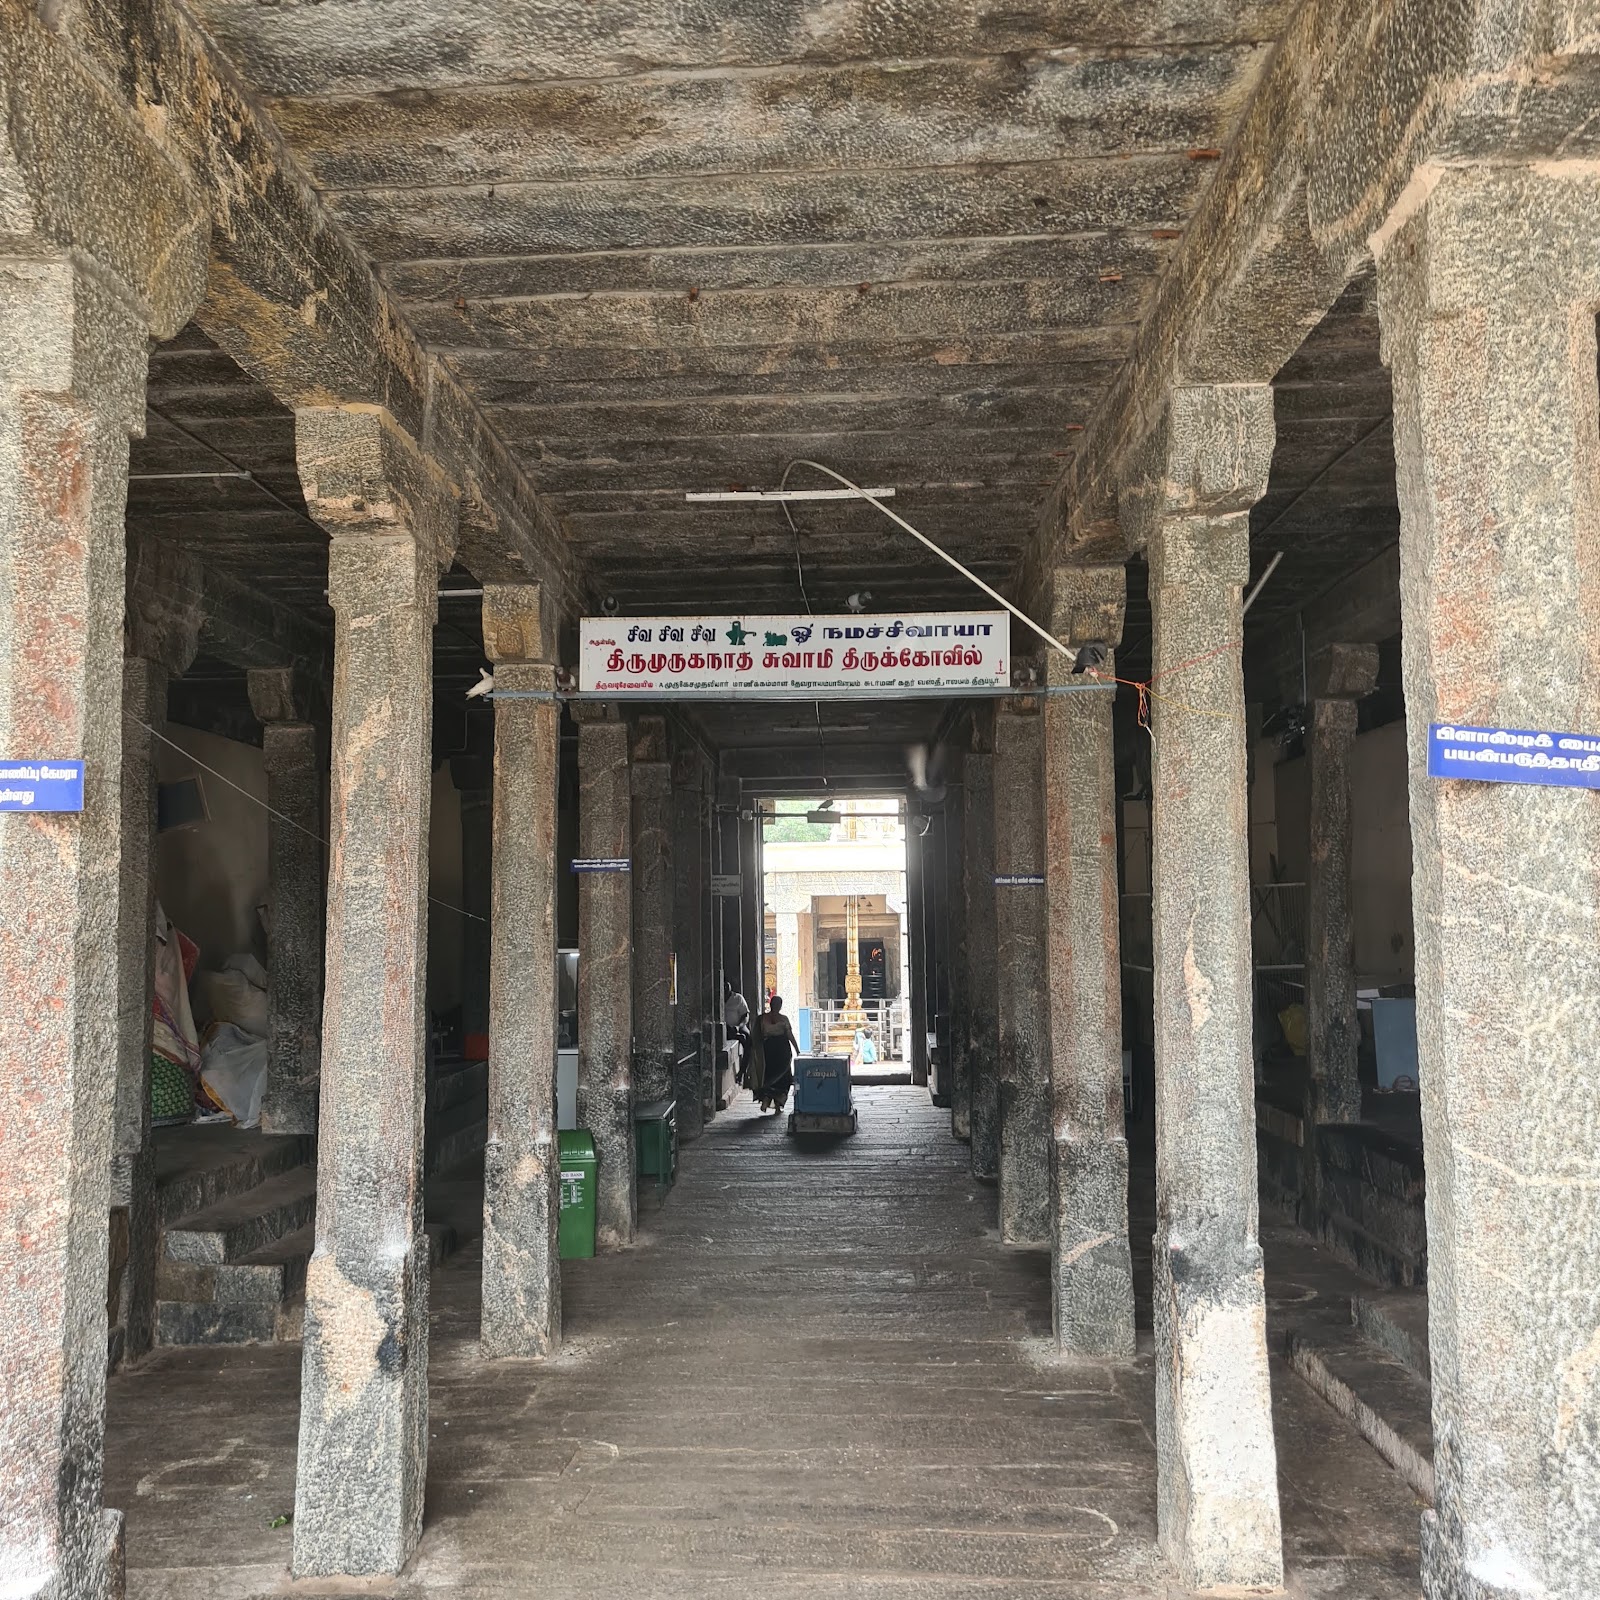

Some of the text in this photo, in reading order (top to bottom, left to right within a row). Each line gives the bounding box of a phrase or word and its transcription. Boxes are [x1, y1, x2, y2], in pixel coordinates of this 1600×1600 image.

[627, 625, 653, 643] சிவ
[658, 625, 685, 643] சிவ
[606, 644, 984, 674] திருமுருகநாத சுவாமி திருக்கோவில்
[1436, 726, 1554, 748] பிளாஸ்டிக்
[41, 765, 78, 781] கேமரா
